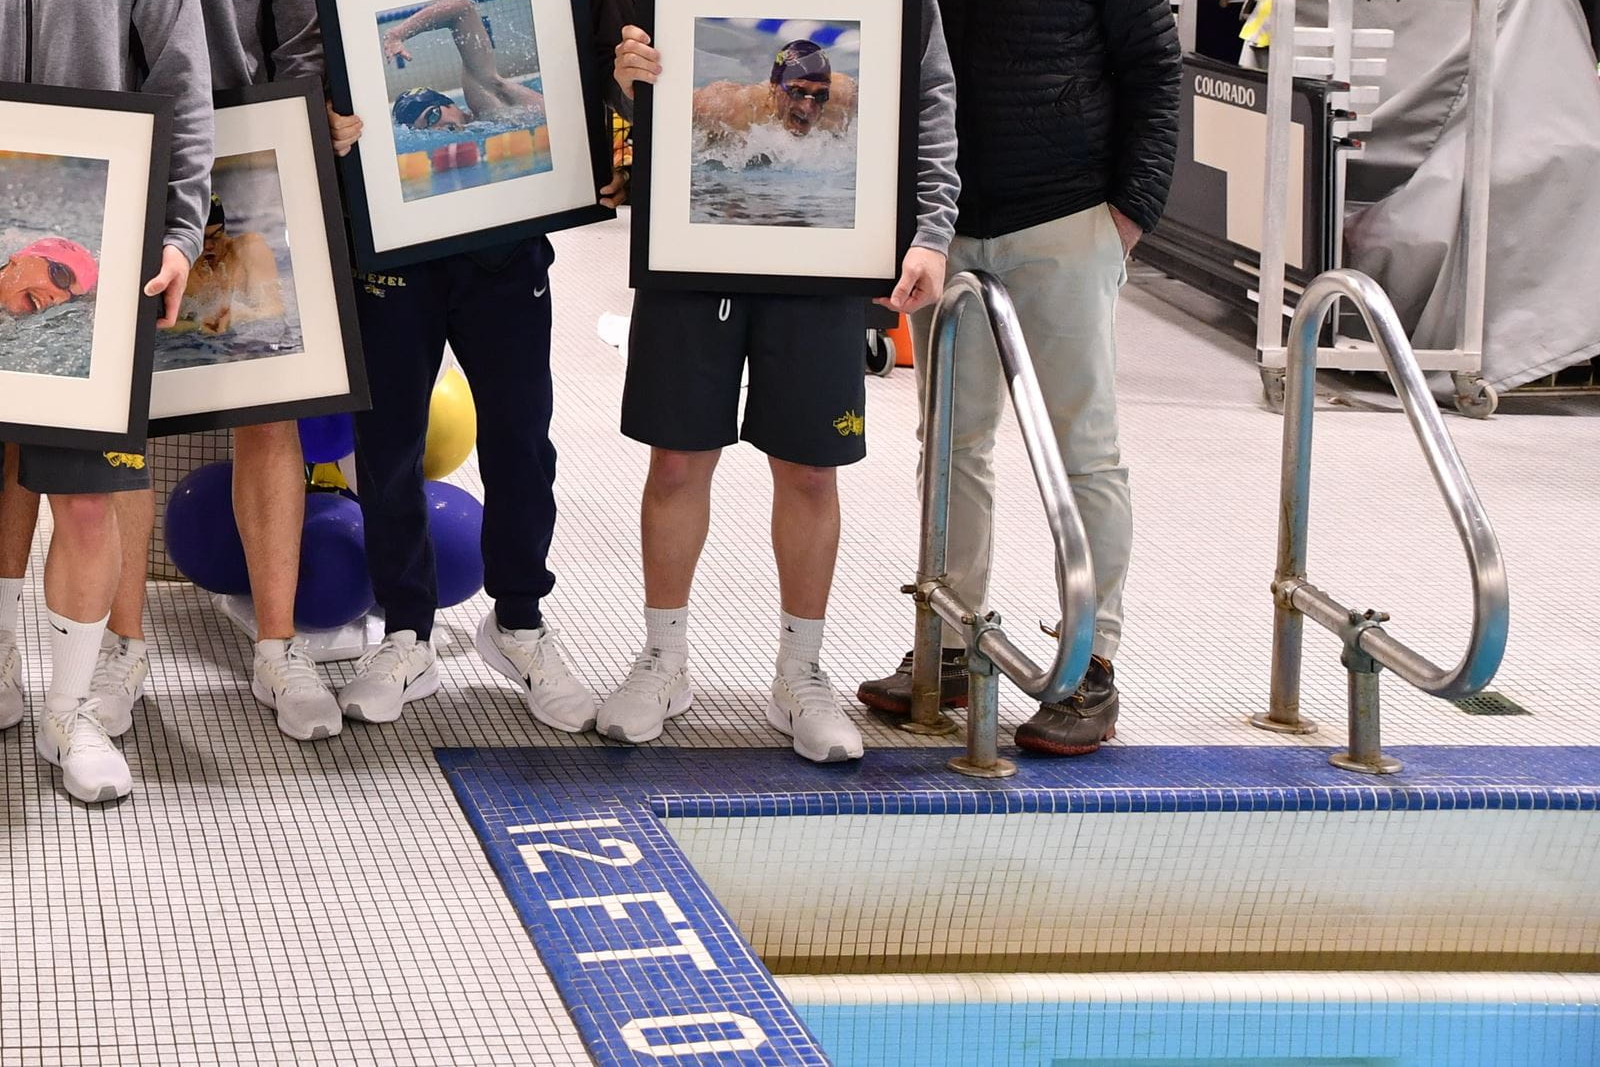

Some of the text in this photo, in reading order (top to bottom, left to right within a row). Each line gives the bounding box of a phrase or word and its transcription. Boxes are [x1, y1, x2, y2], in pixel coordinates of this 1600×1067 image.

[1194, 74, 1255, 107] COLORADO
[507, 817, 643, 873] 12
[548, 891, 718, 971] FT
